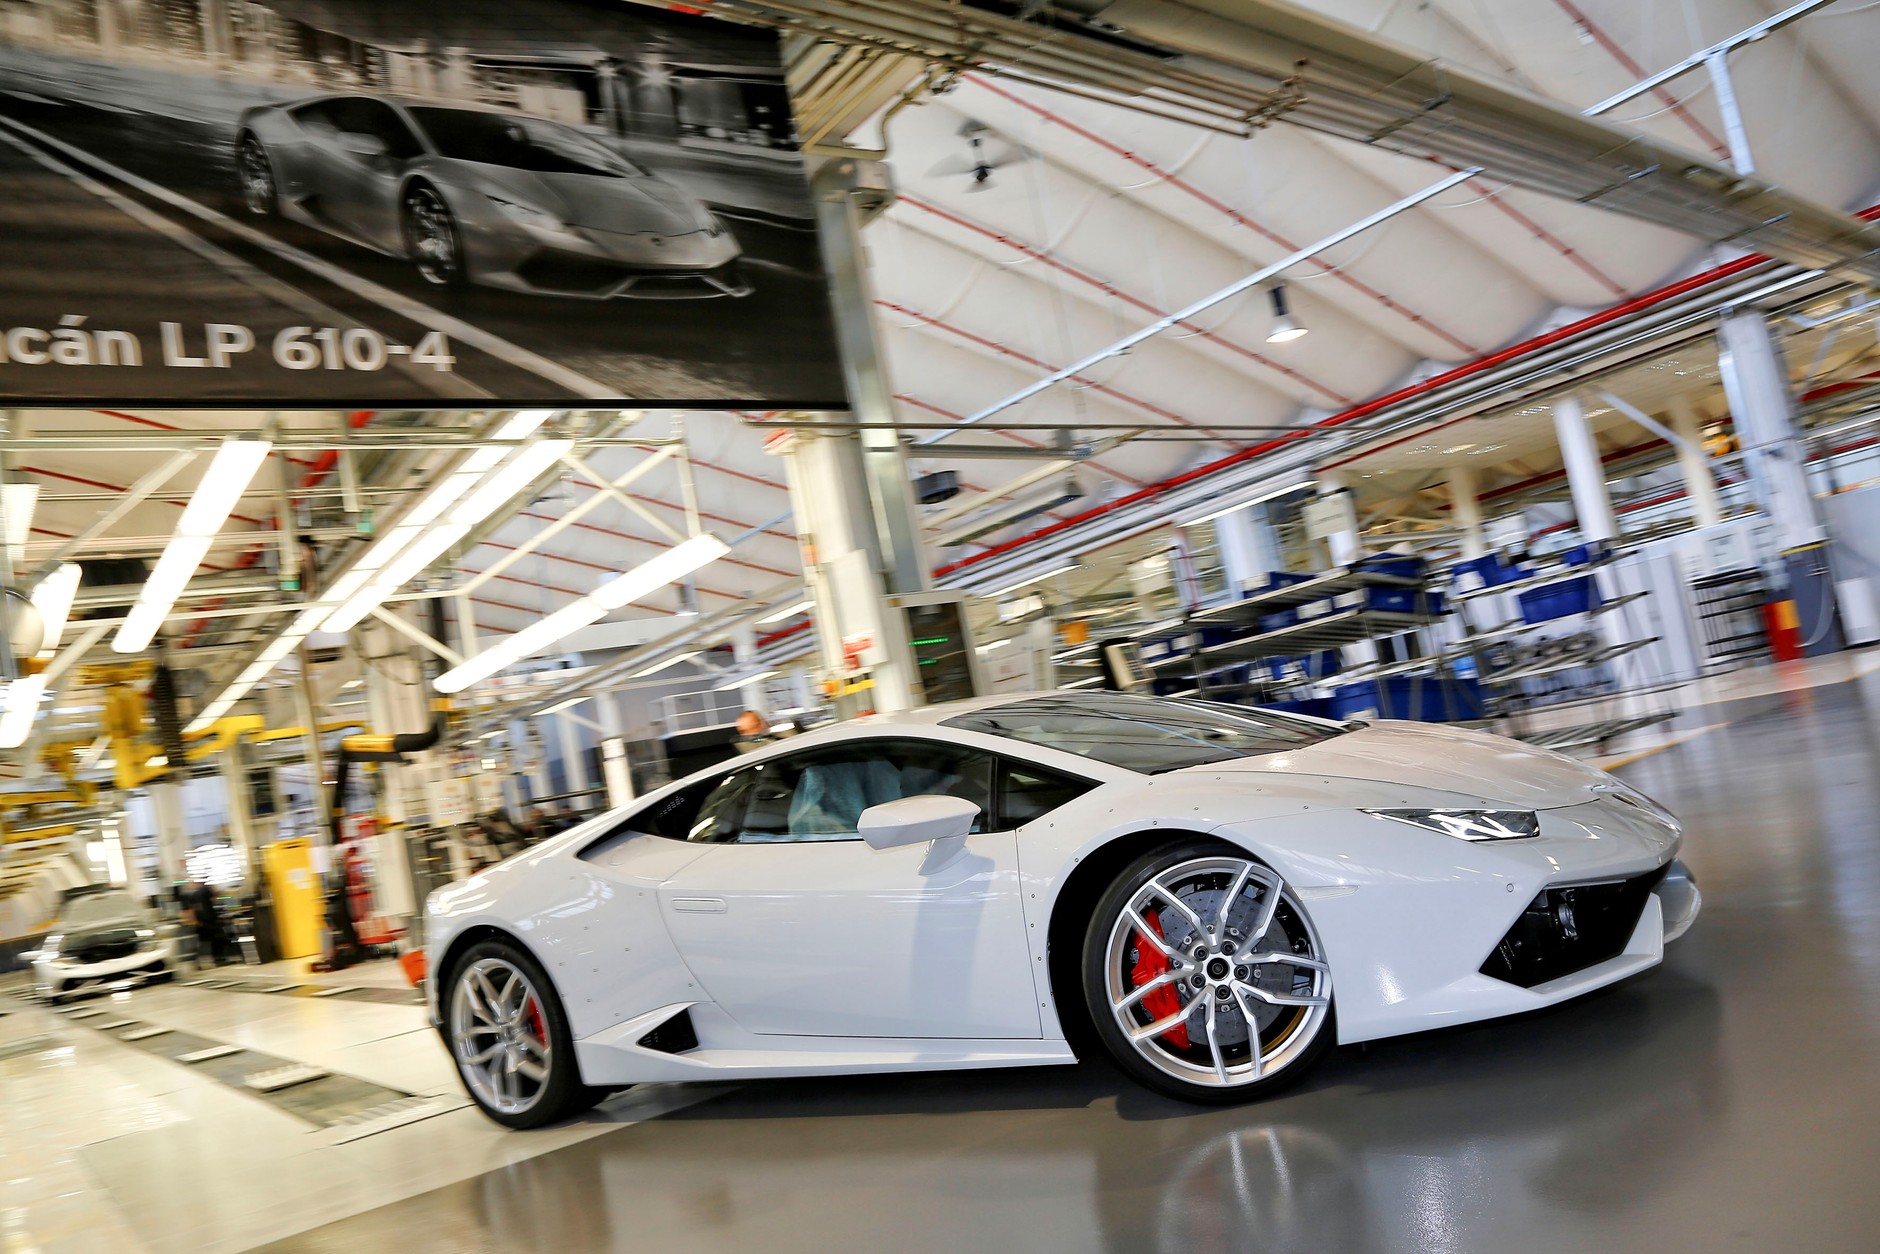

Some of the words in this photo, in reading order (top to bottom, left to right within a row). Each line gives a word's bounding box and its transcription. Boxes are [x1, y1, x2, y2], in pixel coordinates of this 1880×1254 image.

[0, 314, 143, 366] cán
[160, 321, 255, 368] LP
[272, 326, 457, 372] 610-4
